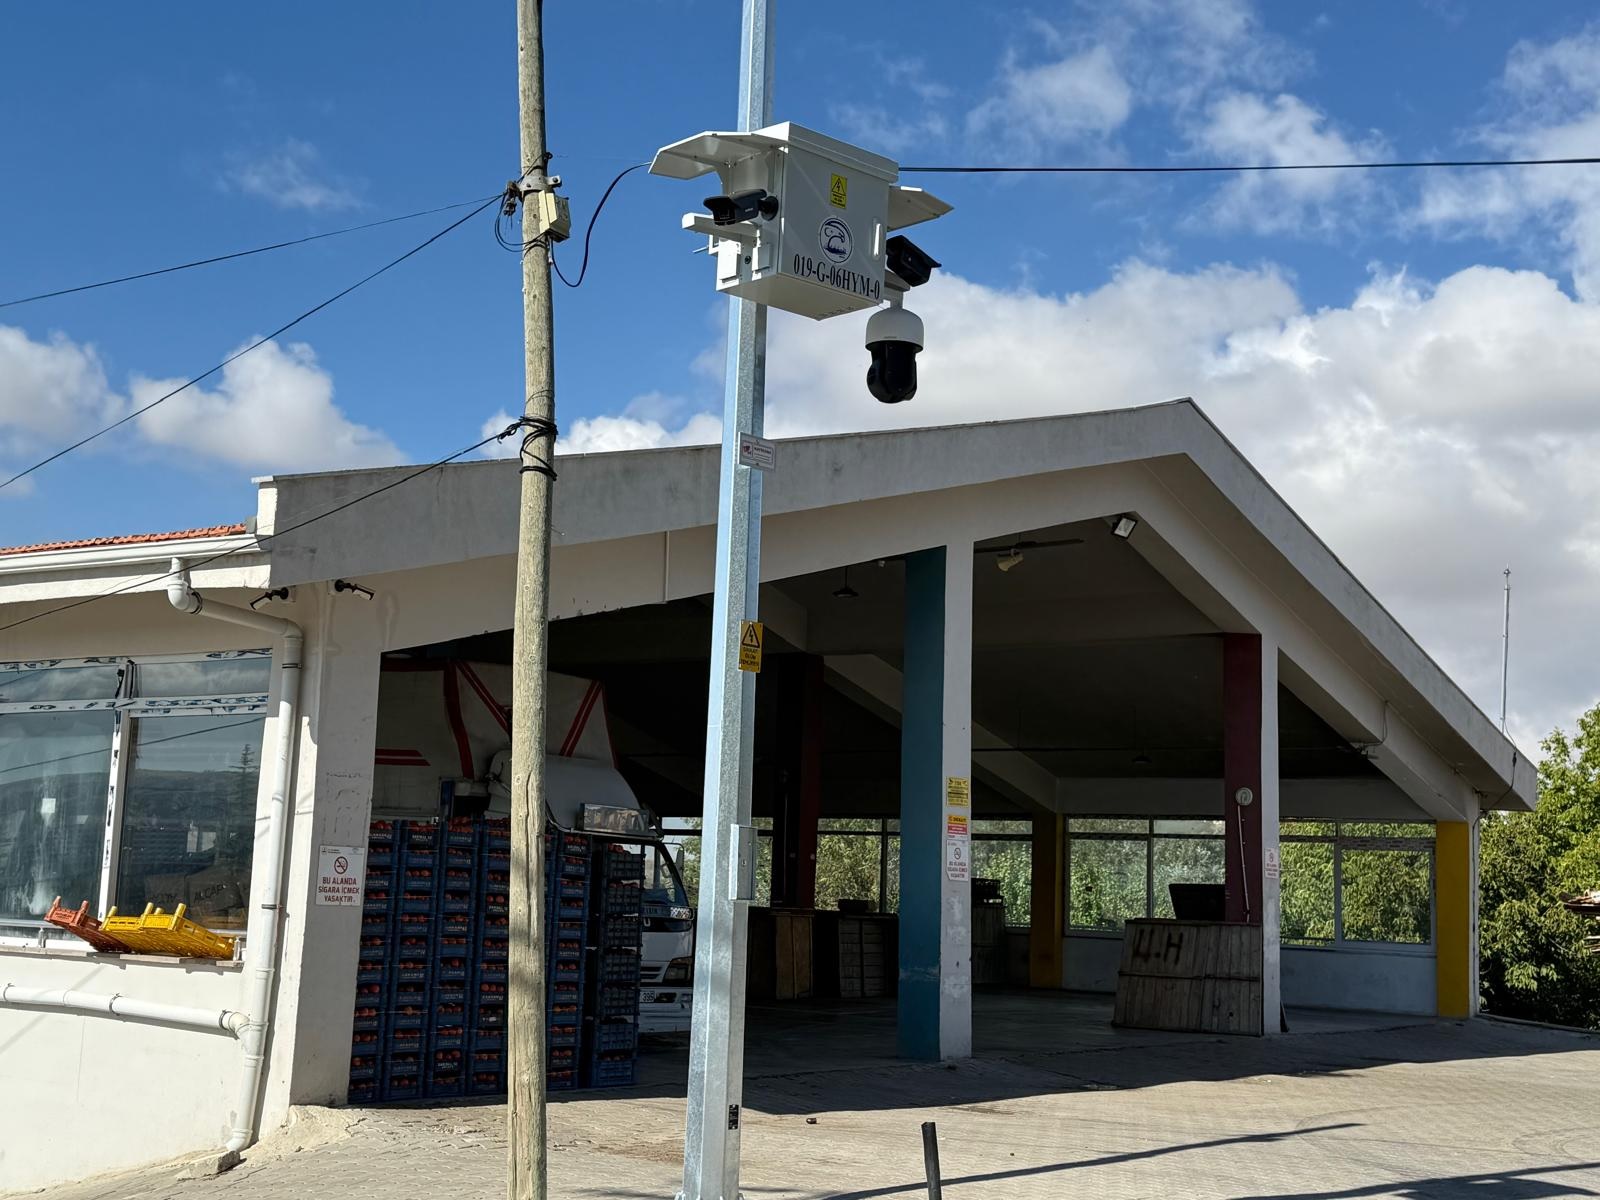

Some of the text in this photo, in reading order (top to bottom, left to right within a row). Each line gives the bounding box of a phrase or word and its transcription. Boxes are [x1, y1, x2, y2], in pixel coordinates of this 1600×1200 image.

[793, 254, 881, 300] 019-G-06HYM-0
[322, 876, 331, 885] BU
[332, 877, 357, 886] ALANDA
